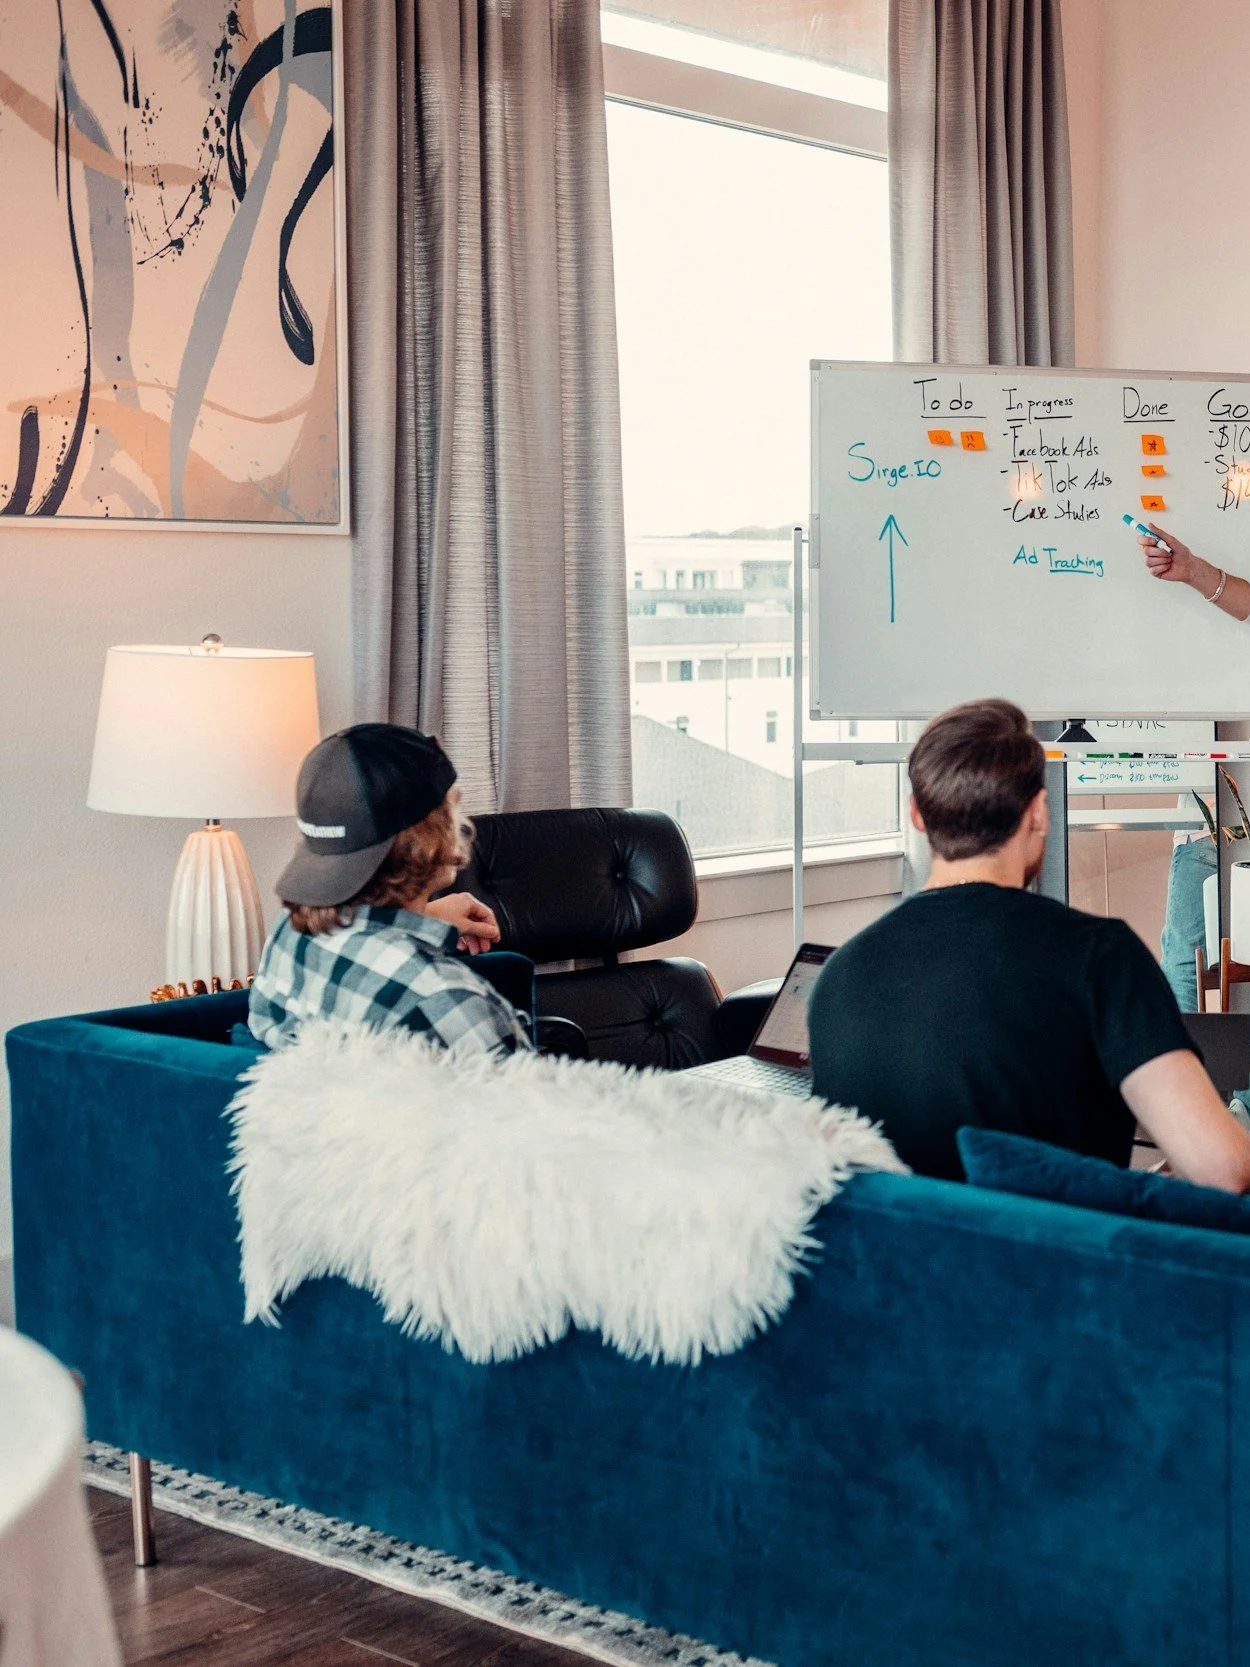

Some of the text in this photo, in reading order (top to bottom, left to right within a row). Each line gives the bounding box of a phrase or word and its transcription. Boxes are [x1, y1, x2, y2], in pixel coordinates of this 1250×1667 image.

[913, 378, 973, 411] To do
[1002, 388, 1073, 424] In progress
[1123, 386, 1169, 419] Done
[1073, 436, 1099, 458] Ads
[847, 442, 942, 487] Sirge.IO
[1084, 468, 1112, 490] Ads
[1054, 500, 1100, 522] Studies
[1013, 545, 1038, 565] Ad
